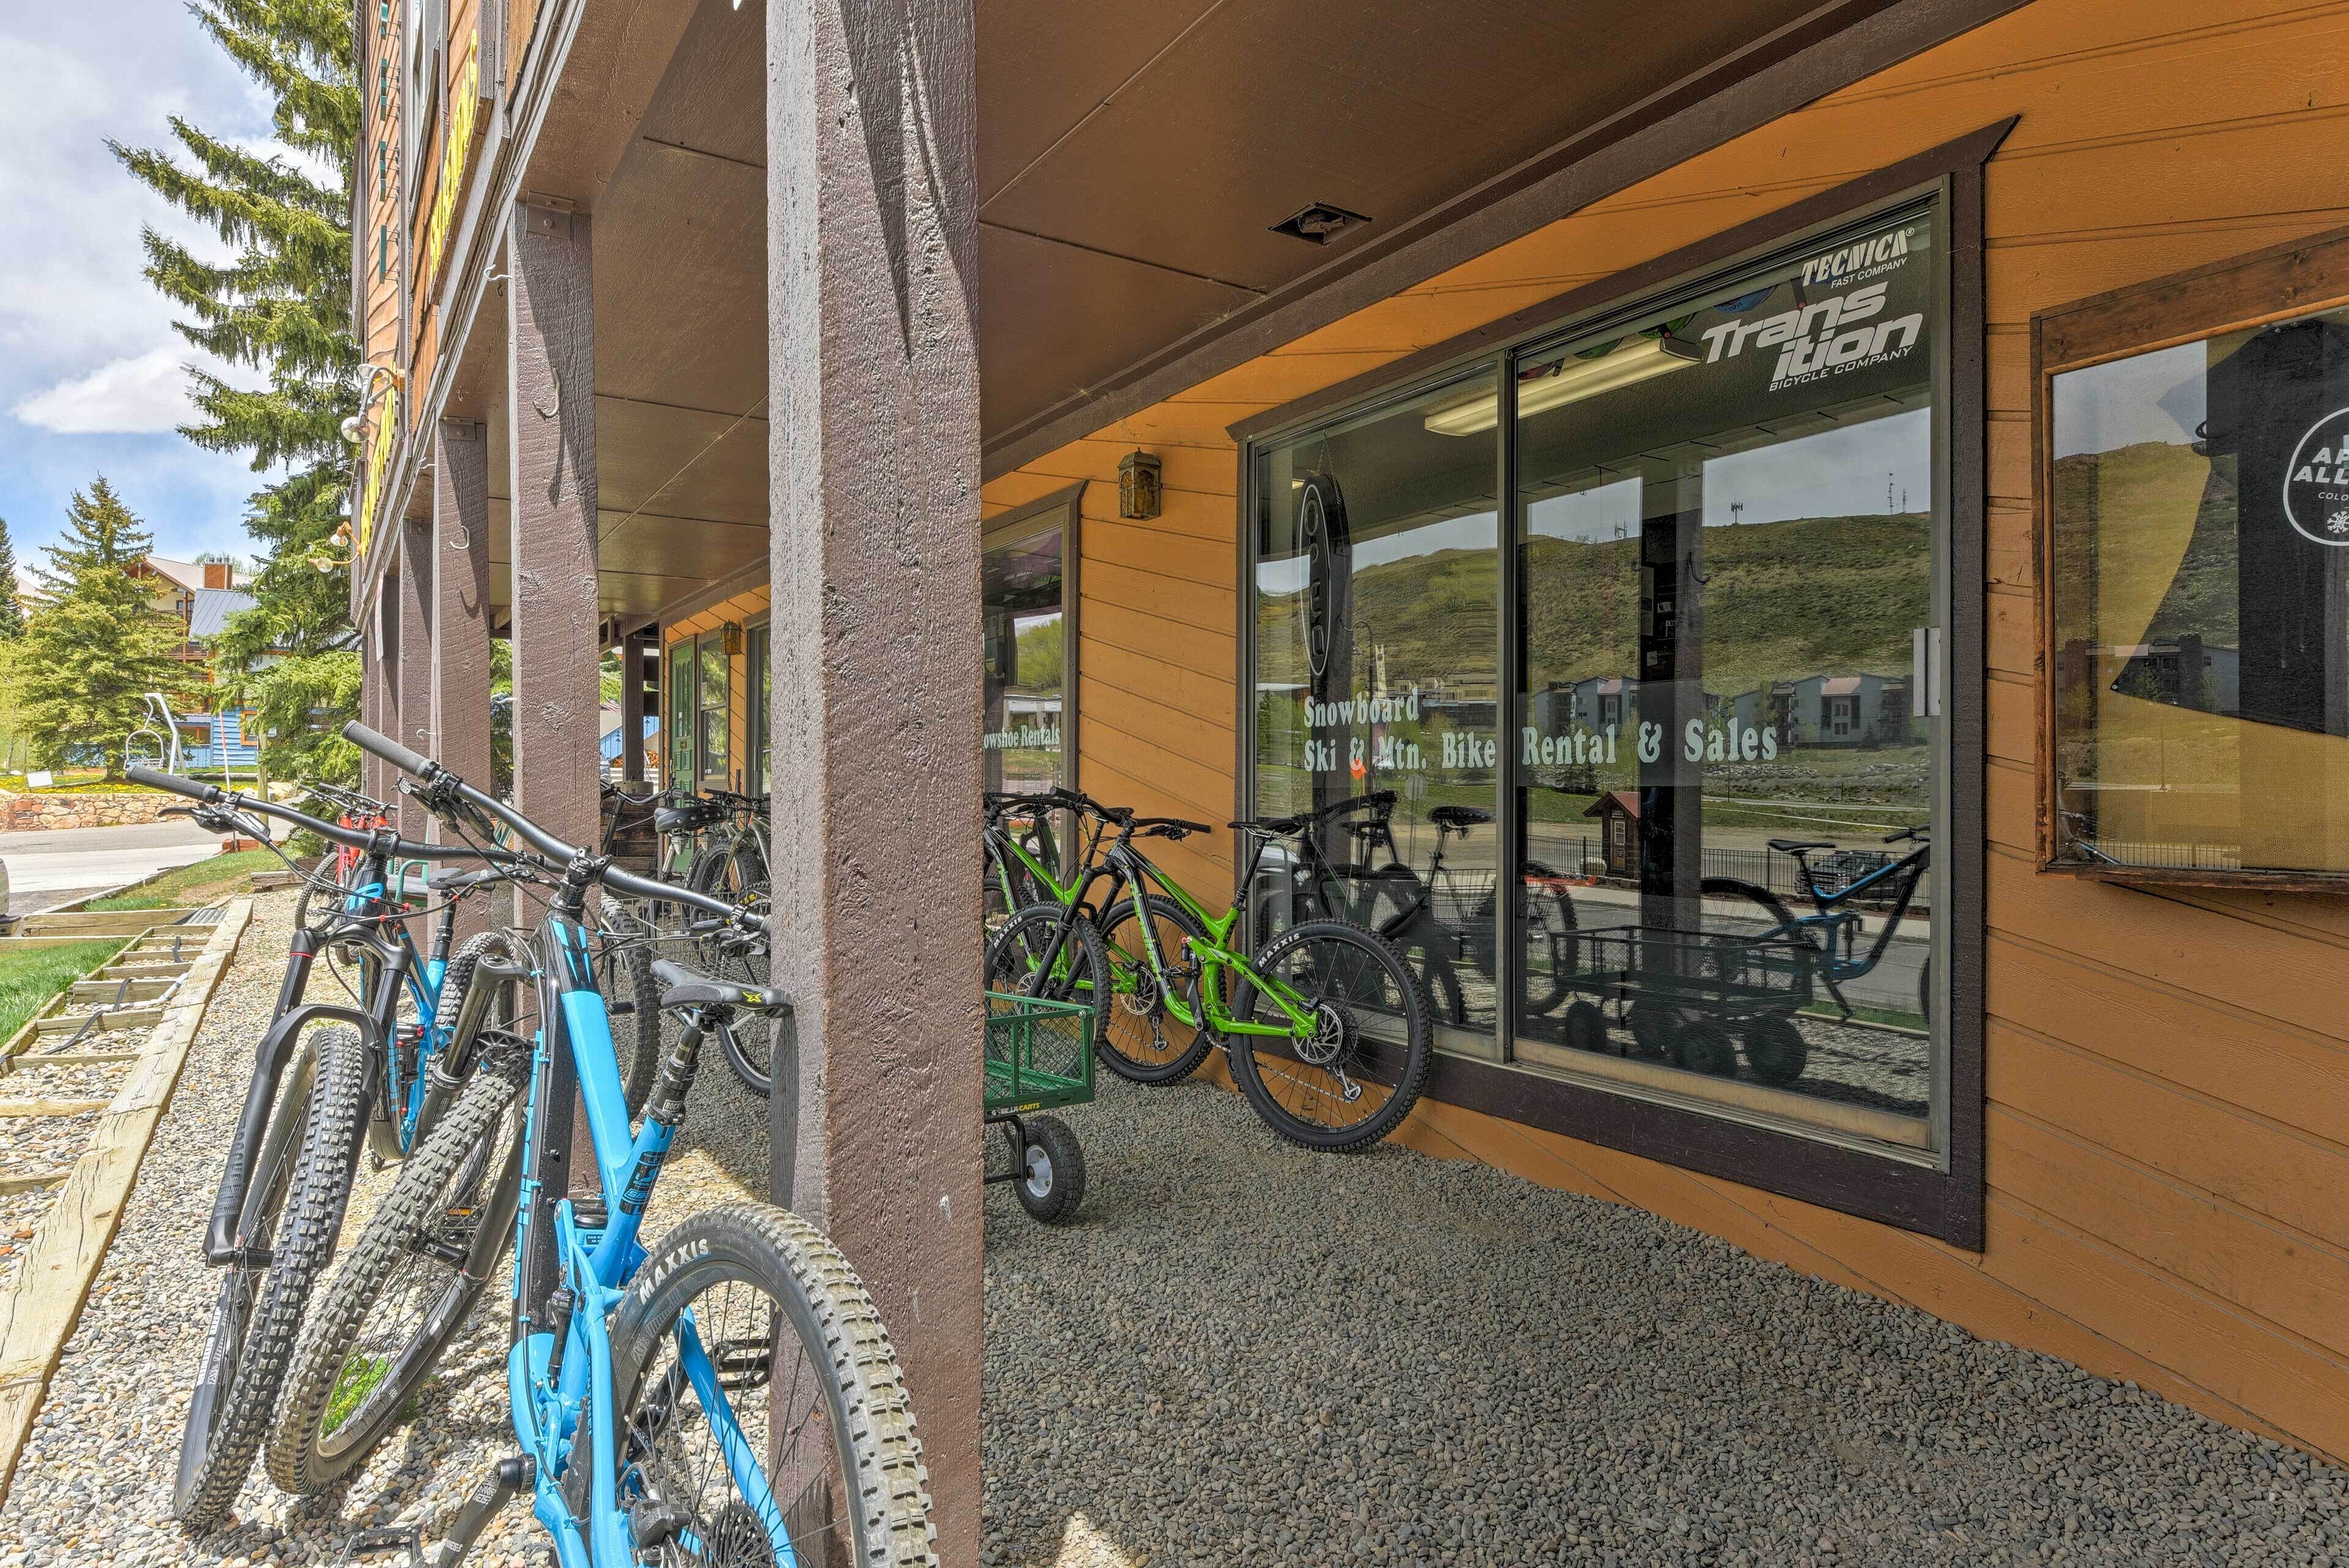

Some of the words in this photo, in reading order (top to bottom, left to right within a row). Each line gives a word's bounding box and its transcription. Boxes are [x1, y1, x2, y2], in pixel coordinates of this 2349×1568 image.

[1801, 229, 1908, 287] TECNICA
[1831, 273, 1855, 289] FAST
[1858, 257, 1907, 281] COMPANY
[1701, 281, 1888, 364] Trans
[1772, 314, 1923, 382] ition
[1769, 368, 1830, 391] BICYCLE
[1835, 346, 1913, 375] COMPANY
[2293, 466, 2349, 484] ALL
[2318, 492, 2348, 501] COLO
[1304, 687, 1419, 728] Snowboard
[984, 727, 1019, 749] owshoe
[1021, 723, 1060, 747] Rentals
[1304, 738, 1337, 772] Ski
[1349, 737, 1365, 771] &
[1378, 736, 1427, 771] Mtn.
[1441, 731, 1496, 769] Bike
[1521, 723, 1616, 766] Rental
[1637, 721, 1662, 763] &
[1684, 717, 1778, 762] Sales
[993, 916, 1022, 949] MAXXIS
[1258, 933, 1301, 967] MAXXIS
[1019, 1103, 1040, 1111] CARTS
[640, 1238, 709, 1306] MAXXIS
